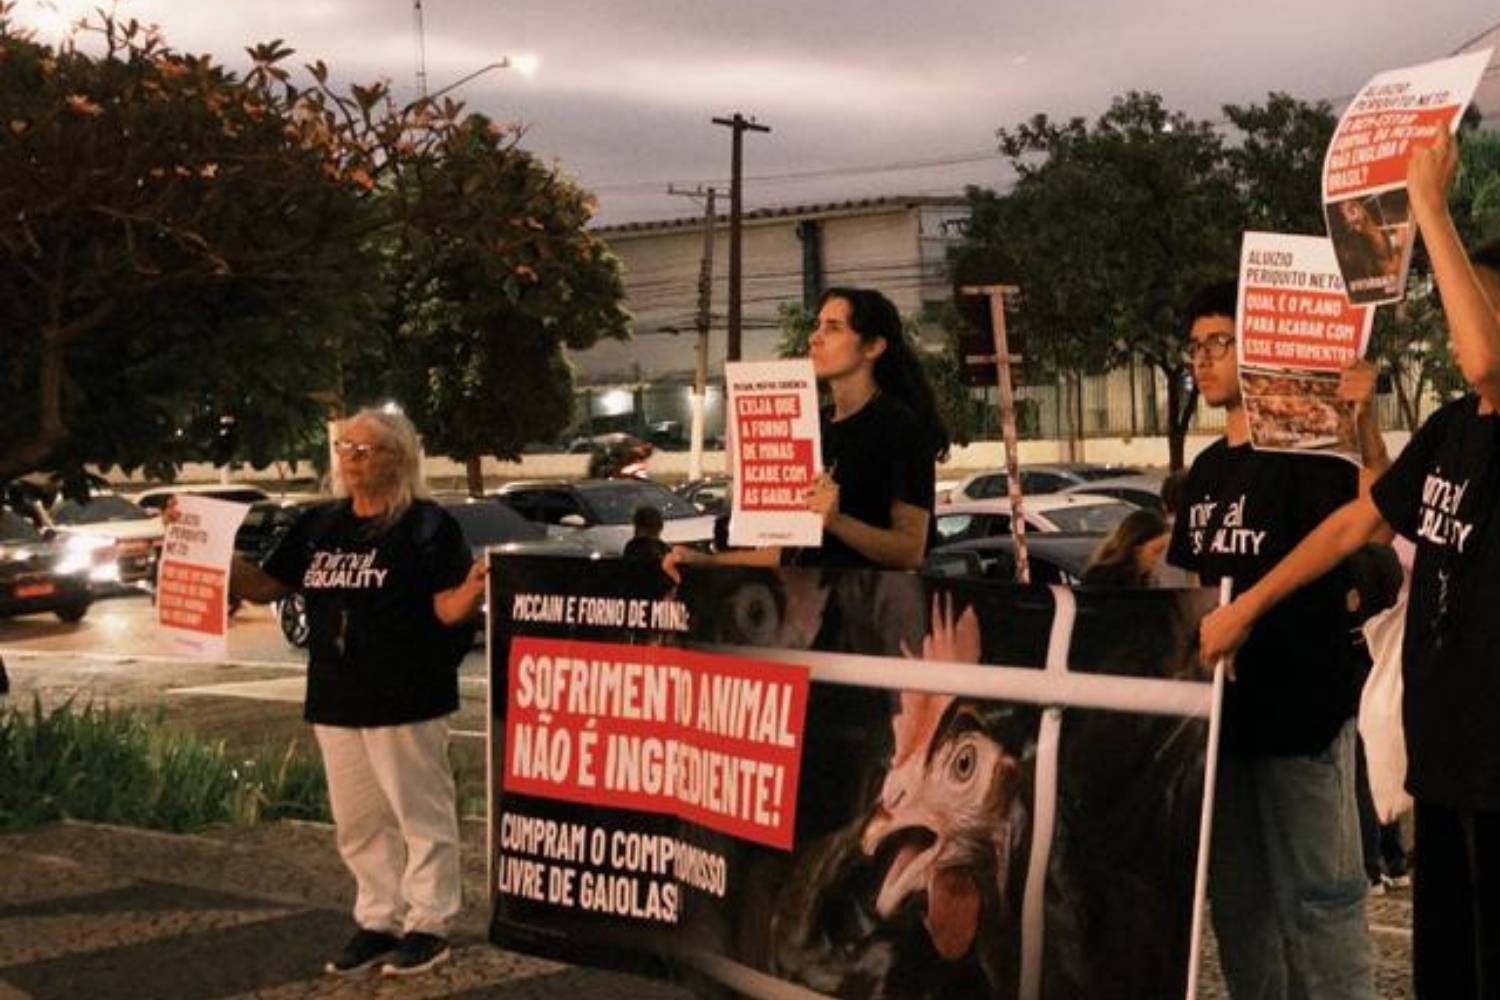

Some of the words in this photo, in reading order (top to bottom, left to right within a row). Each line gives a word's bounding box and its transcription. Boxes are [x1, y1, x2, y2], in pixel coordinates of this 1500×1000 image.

[1246, 268, 1307, 286] PERIQUITO
[1248, 250, 1293, 267] ALUIZIO
[1300, 297, 1341, 318] PLANO
[512, 594, 564, 623] MCCAIN
[565, 595, 575, 624] E
[577, 596, 625, 627] FORNO
[628, 600, 648, 629] DE
[516, 653, 693, 727] SOFRIMENTO
[696, 672, 796, 748] ANIMAL
[511, 713, 571, 785] NÃO
[577, 717, 597, 790] É
[604, 733, 785, 828] INGREDIENTE!
[500, 811, 587, 864] CUMPRAM
[590, 827, 606, 867] O
[499, 853, 546, 902] LIVRE
[549, 865, 577, 908] DE
